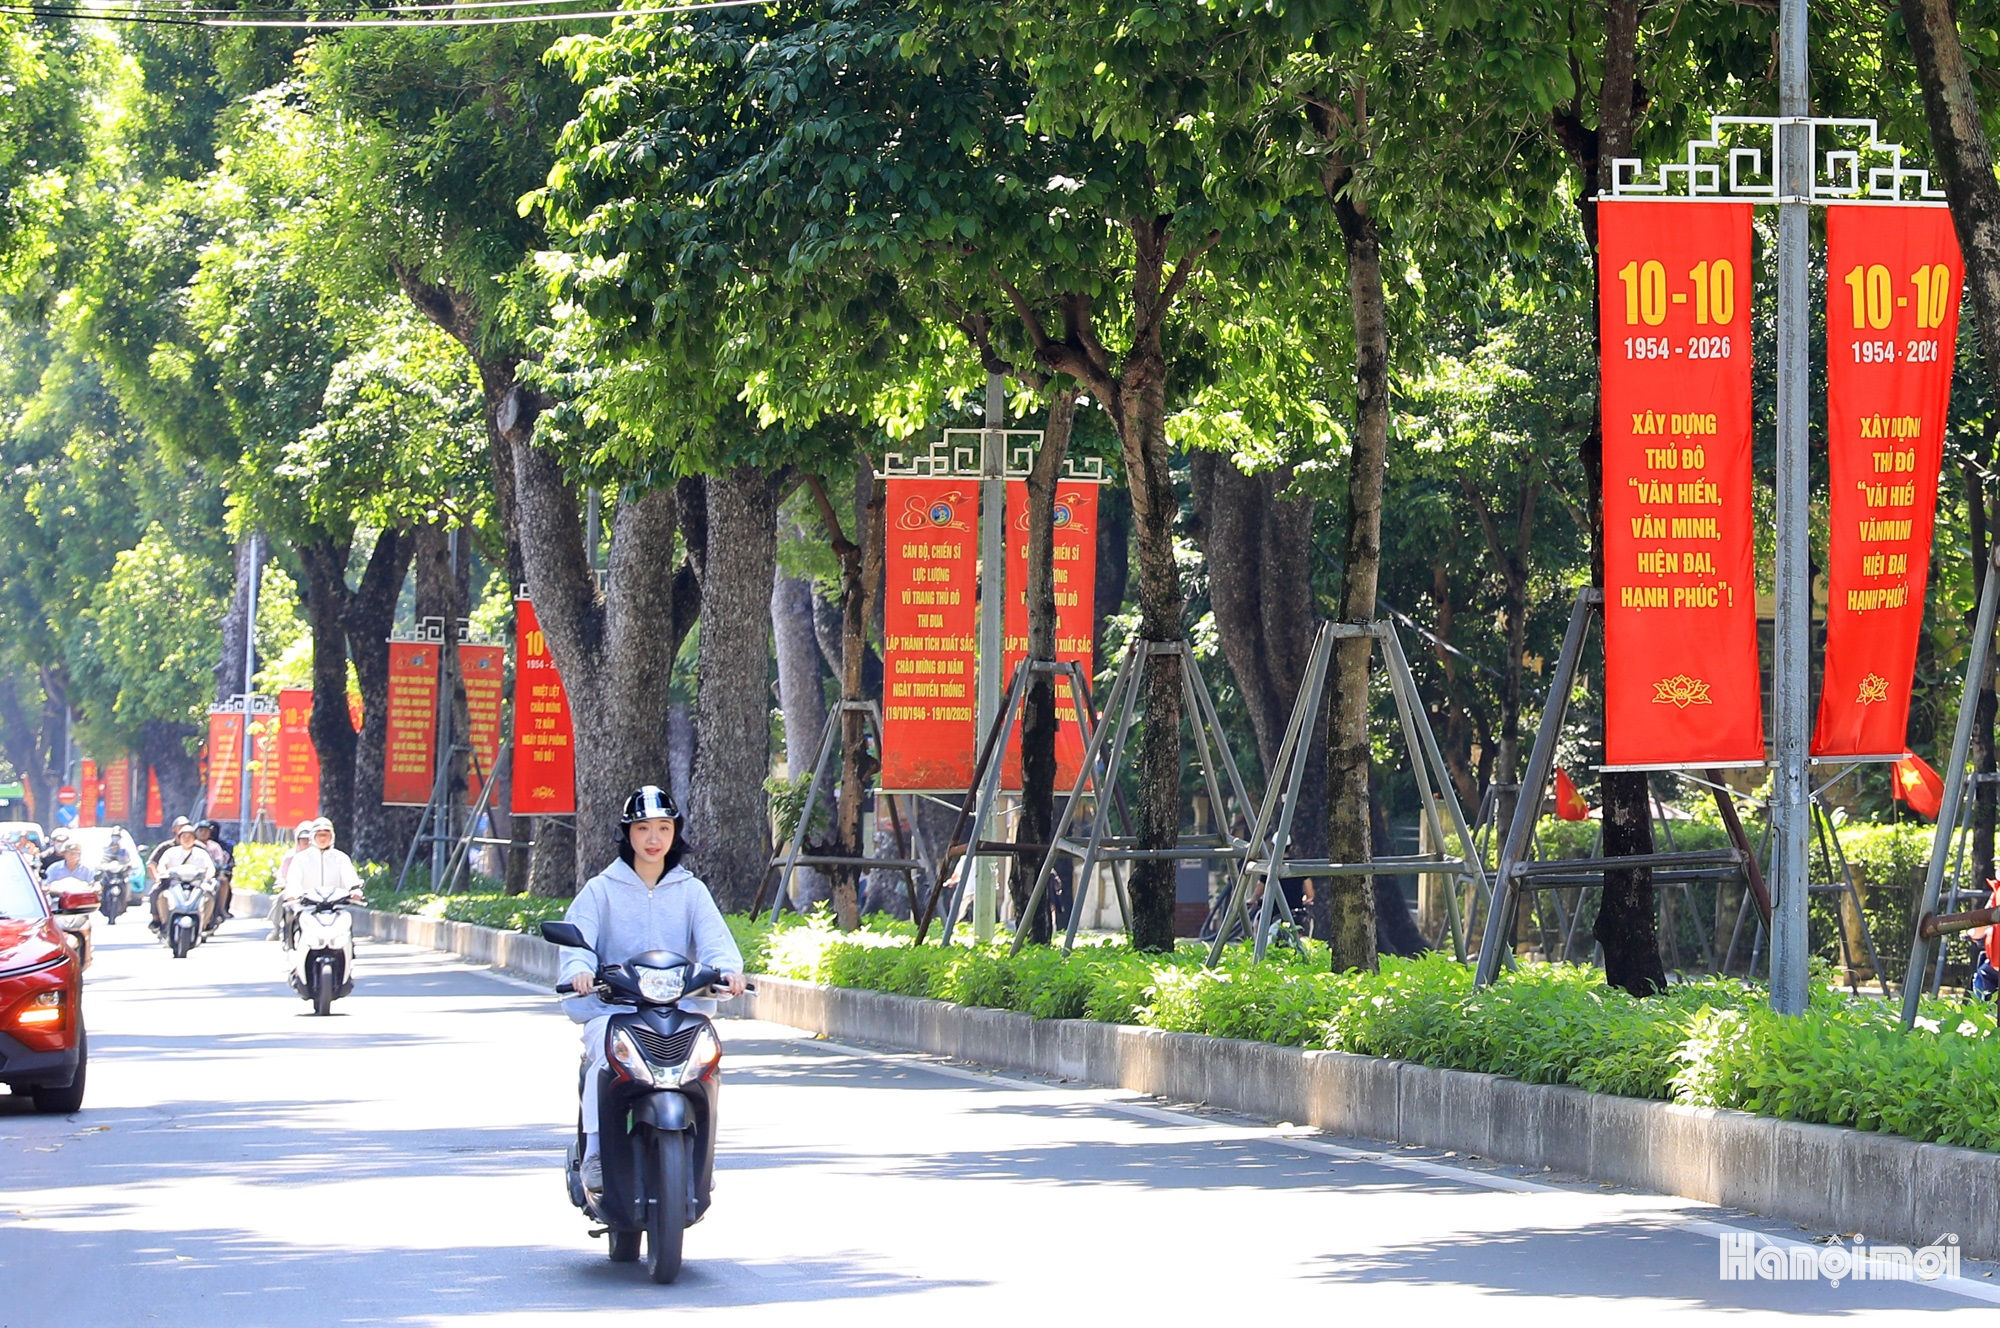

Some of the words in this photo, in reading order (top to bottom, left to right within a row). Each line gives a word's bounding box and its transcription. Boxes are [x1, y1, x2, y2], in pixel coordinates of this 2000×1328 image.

[1624, 337, 1670, 360] 1954
[1688, 336, 1731, 359] 2026
[1851, 341, 1895, 363] 1954
[1632, 409, 1666, 435] XÂY
[1671, 411, 1717, 439] DỰNG
[1860, 413, 1890, 439] XÂY
[1645, 441, 1678, 470] THỦ
[1681, 444, 1705, 470] ĐÔ
[1894, 447, 1915, 473] ĐÔ
[1628, 477, 1673, 504] “VĂN
[1677, 476, 1722, 507] HIẾN,
[1631, 513, 1667, 539] VĂN
[1671, 517, 1721, 541] MINH,
[902, 542, 917, 559] CÁN
[918, 542, 931, 562] BỘ,
[931, 541, 953, 559] CHIẾN
[1637, 548, 1679, 578] HIỆN
[1682, 552, 1716, 578] ĐẠI,
[912, 566, 927, 585] LỰC
[901, 587, 911, 605] VŨ
[912, 590, 935, 605] TRANG
[936, 586, 949, 605] THỦ
[949, 588, 960, 606] ĐÔ
[1621, 586, 1669, 612] HẠNH
[917, 613, 929, 628] THI
[886, 633, 900, 654] LẬP
[924, 634, 940, 651] TÍCH
[940, 632, 959, 651] XUẤT
[959, 632, 975, 652] SẮC
[1005, 634, 1019, 655] LẬP
[1058, 634, 1076, 653] XUẤT
[1076, 634, 1092, 654] SẮC
[947, 658, 964, 675] NĂM
